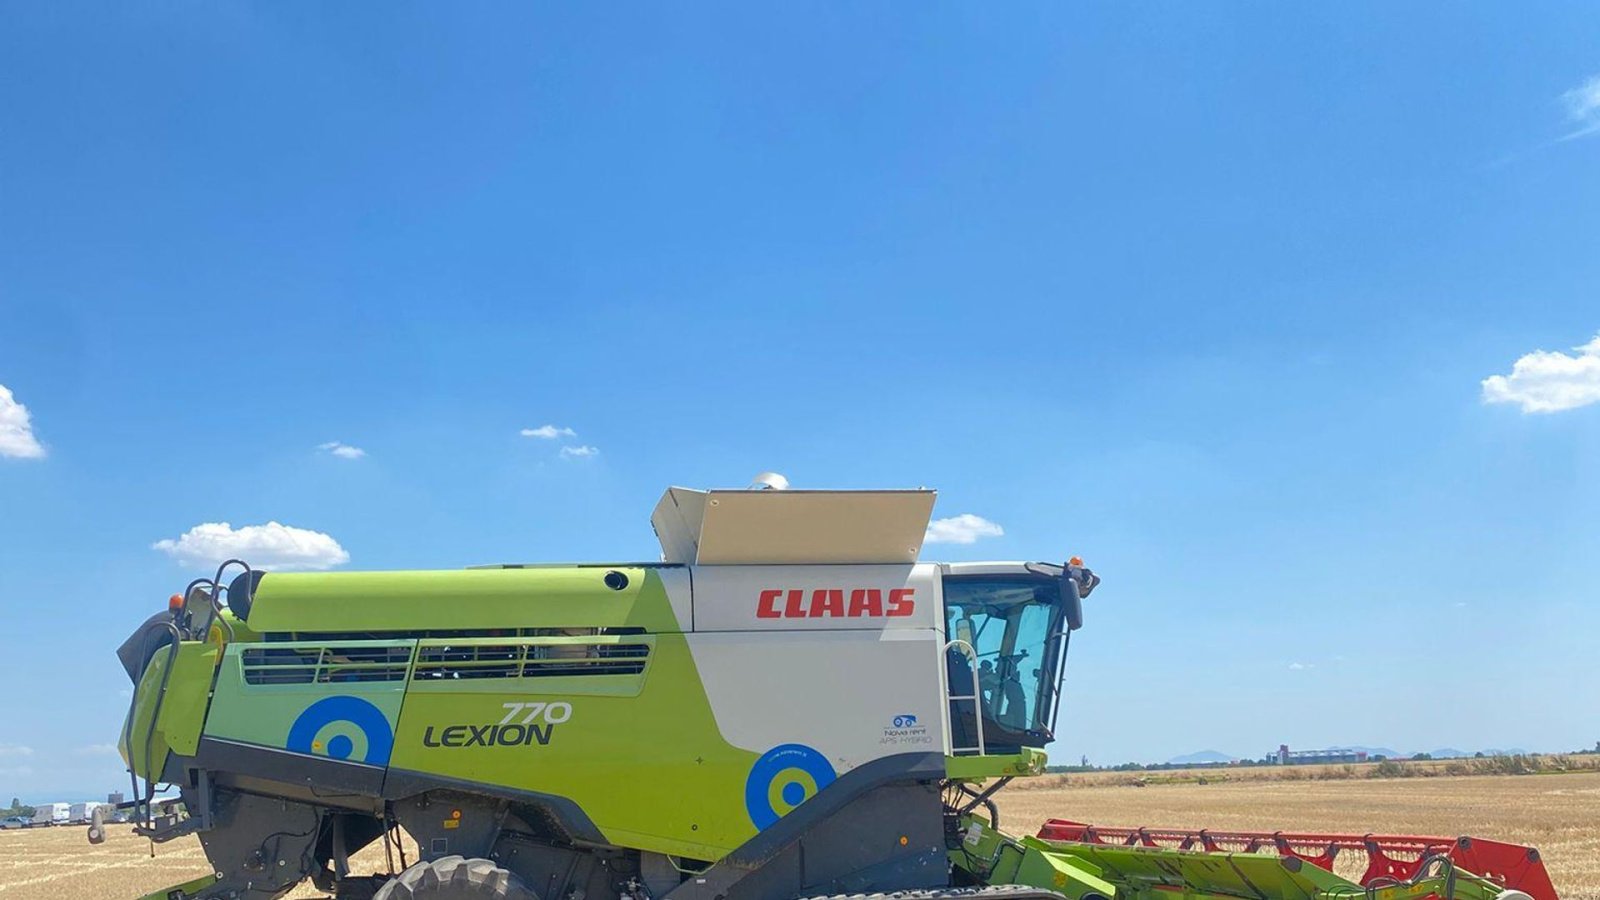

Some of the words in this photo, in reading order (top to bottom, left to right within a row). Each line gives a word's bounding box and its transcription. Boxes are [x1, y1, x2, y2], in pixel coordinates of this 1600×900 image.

[756, 589, 915, 618] CLAAS
[500, 702, 572, 724] 770
[423, 724, 553, 747] LEXION
